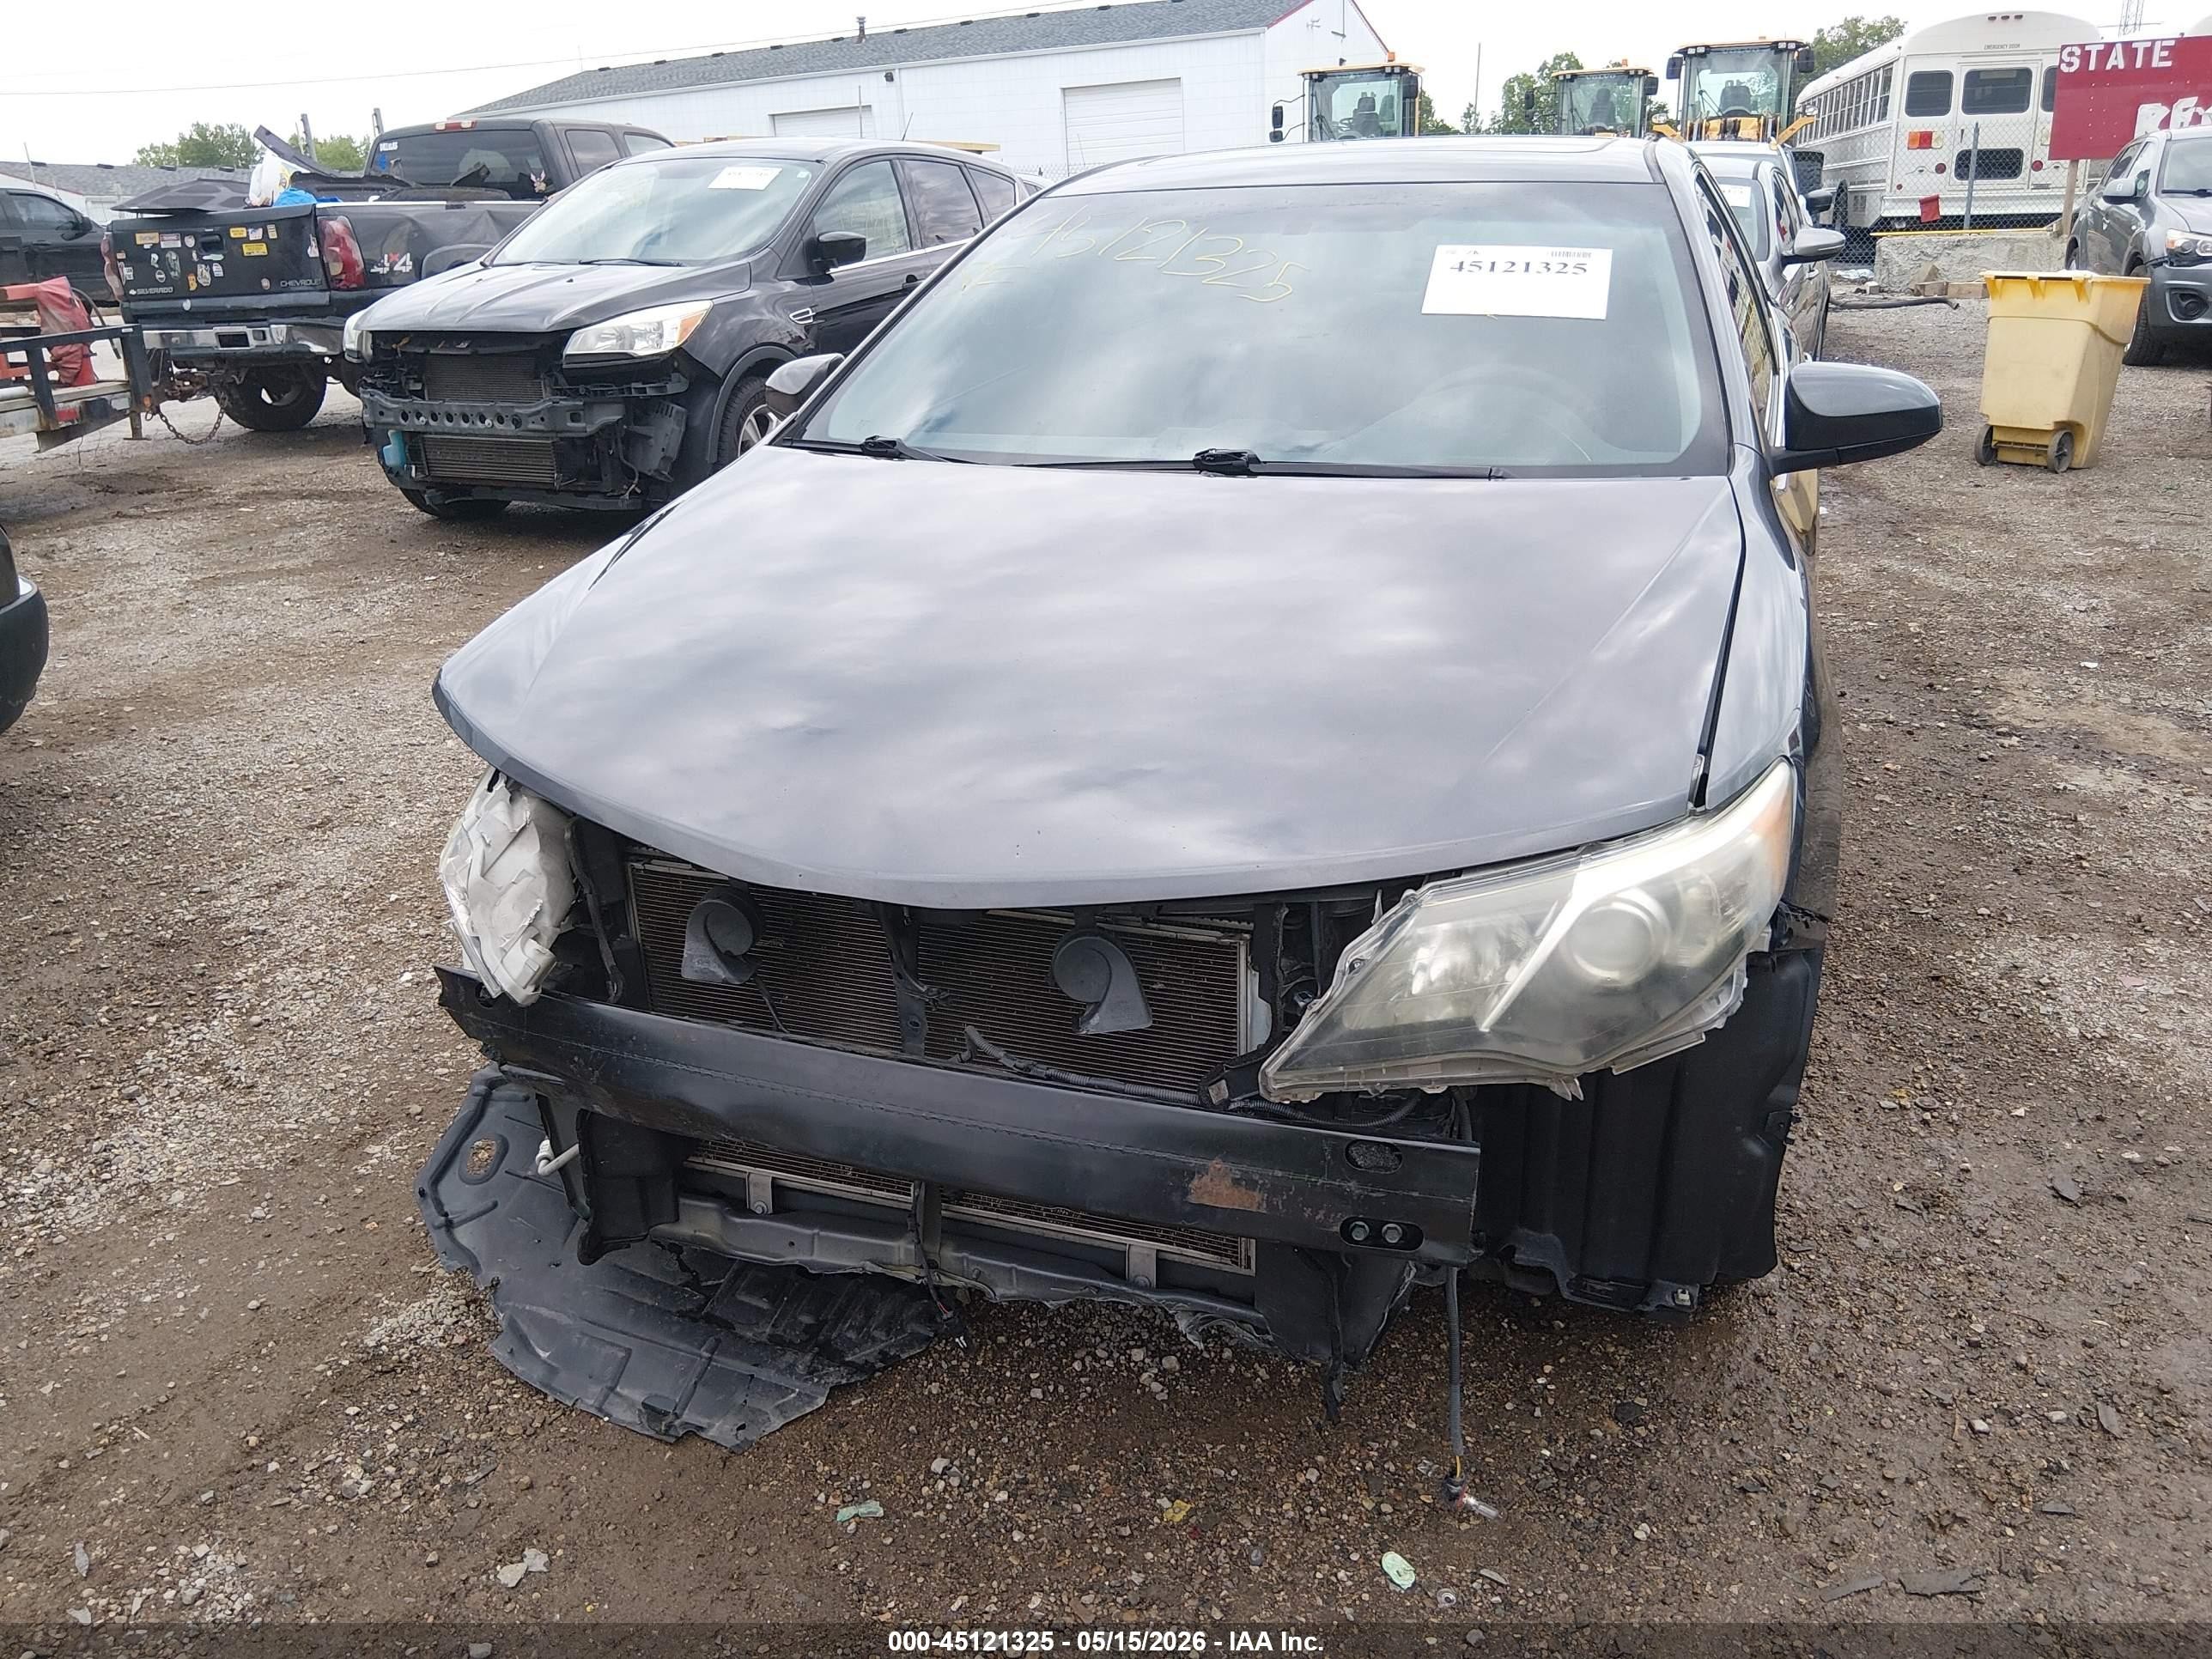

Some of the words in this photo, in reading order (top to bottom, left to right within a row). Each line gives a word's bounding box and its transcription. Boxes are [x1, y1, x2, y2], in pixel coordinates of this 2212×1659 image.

[2060, 40, 2176, 74] STATE
[1449, 260, 1588, 276] 45121325
[137, 286, 174, 295] SILVERADO
